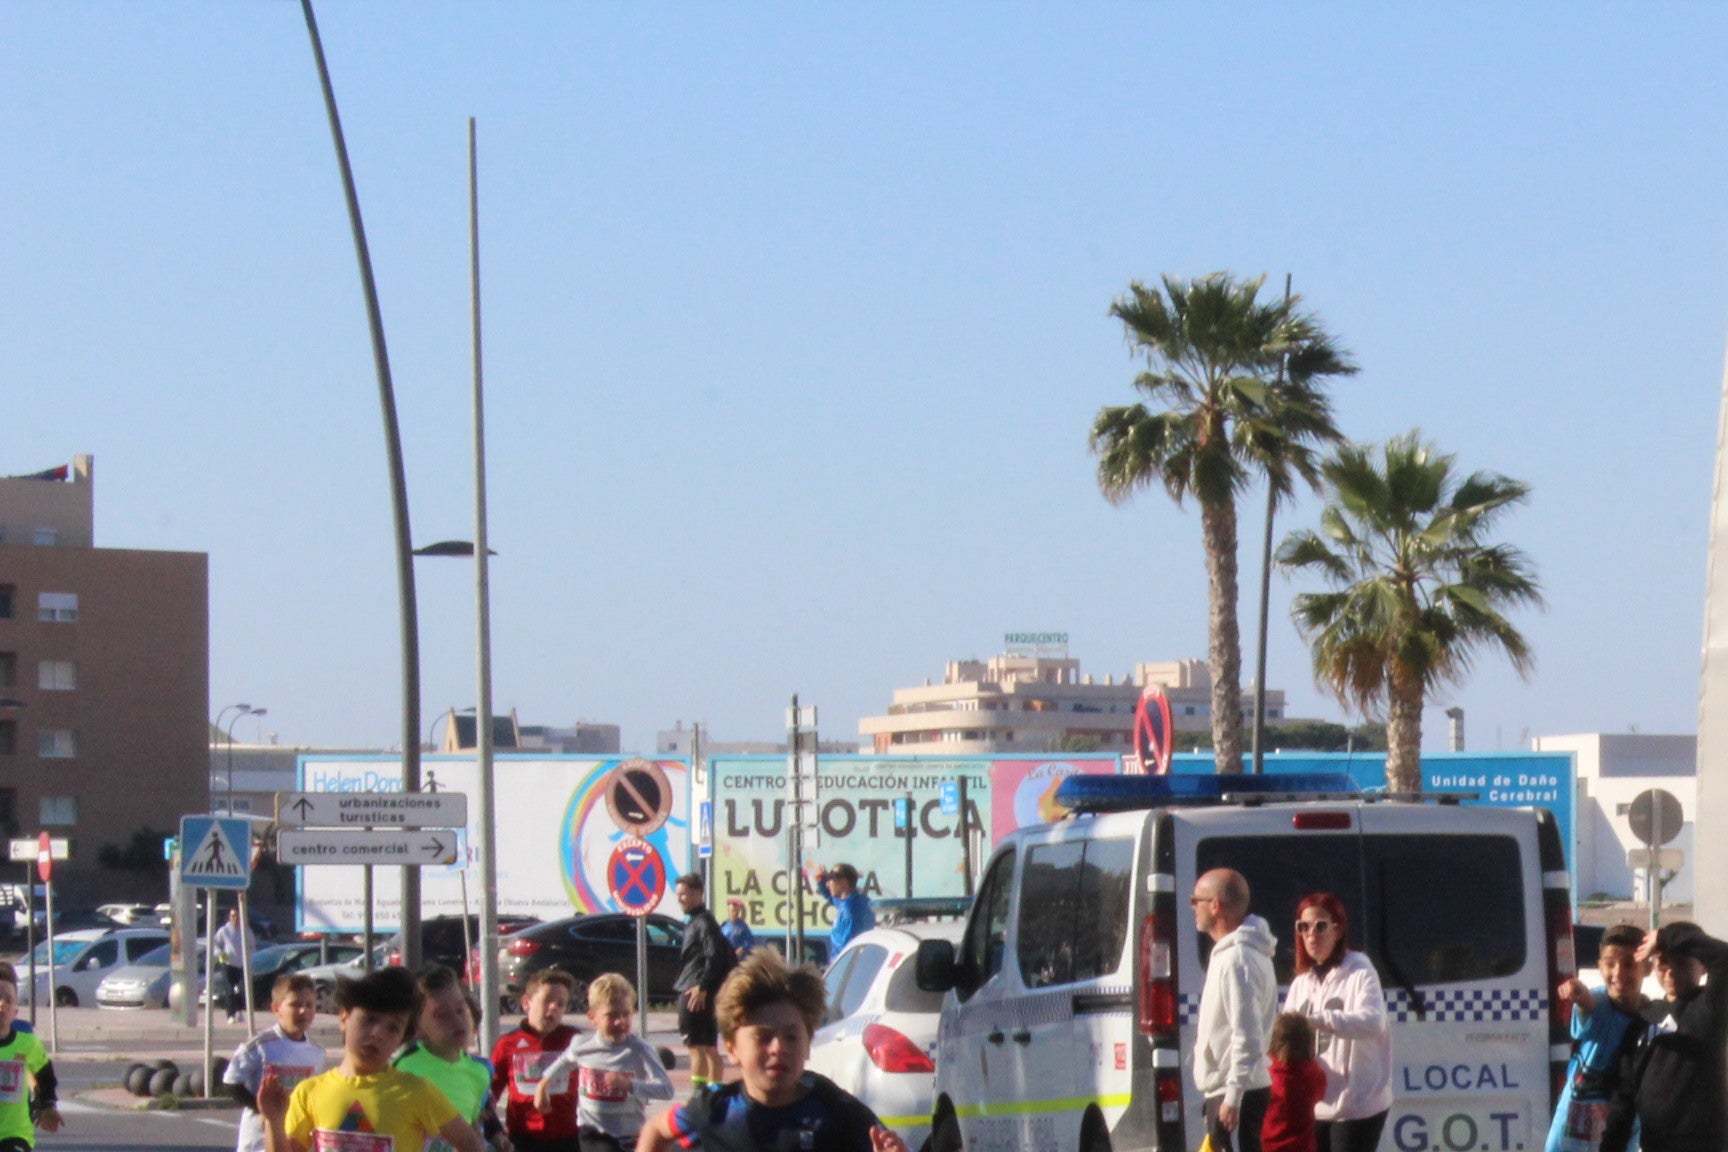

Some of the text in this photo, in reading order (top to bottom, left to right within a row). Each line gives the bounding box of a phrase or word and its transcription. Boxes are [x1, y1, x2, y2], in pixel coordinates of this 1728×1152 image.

[1004, 632, 1069, 644] PARQUECENTRO
[723, 775, 786, 789] CENTRO
[816, 772, 908, 790] EDUCACIÓN
[912, 775, 988, 790] INFTIL
[1431, 773, 1558, 787] Unidad de Daño
[338, 796, 441, 809] urbanizaciones
[1489, 789, 1558, 801] Cerebral
[725, 797, 987, 839] LUOTCA
[292, 843, 409, 855] centro comercial
[616, 838, 653, 854] EXCEPTO
[724, 869, 883, 896] LA CAA
[1403, 1063, 1520, 1091] LOCAL
[1393, 1112, 1524, 1152] G.O.T.
